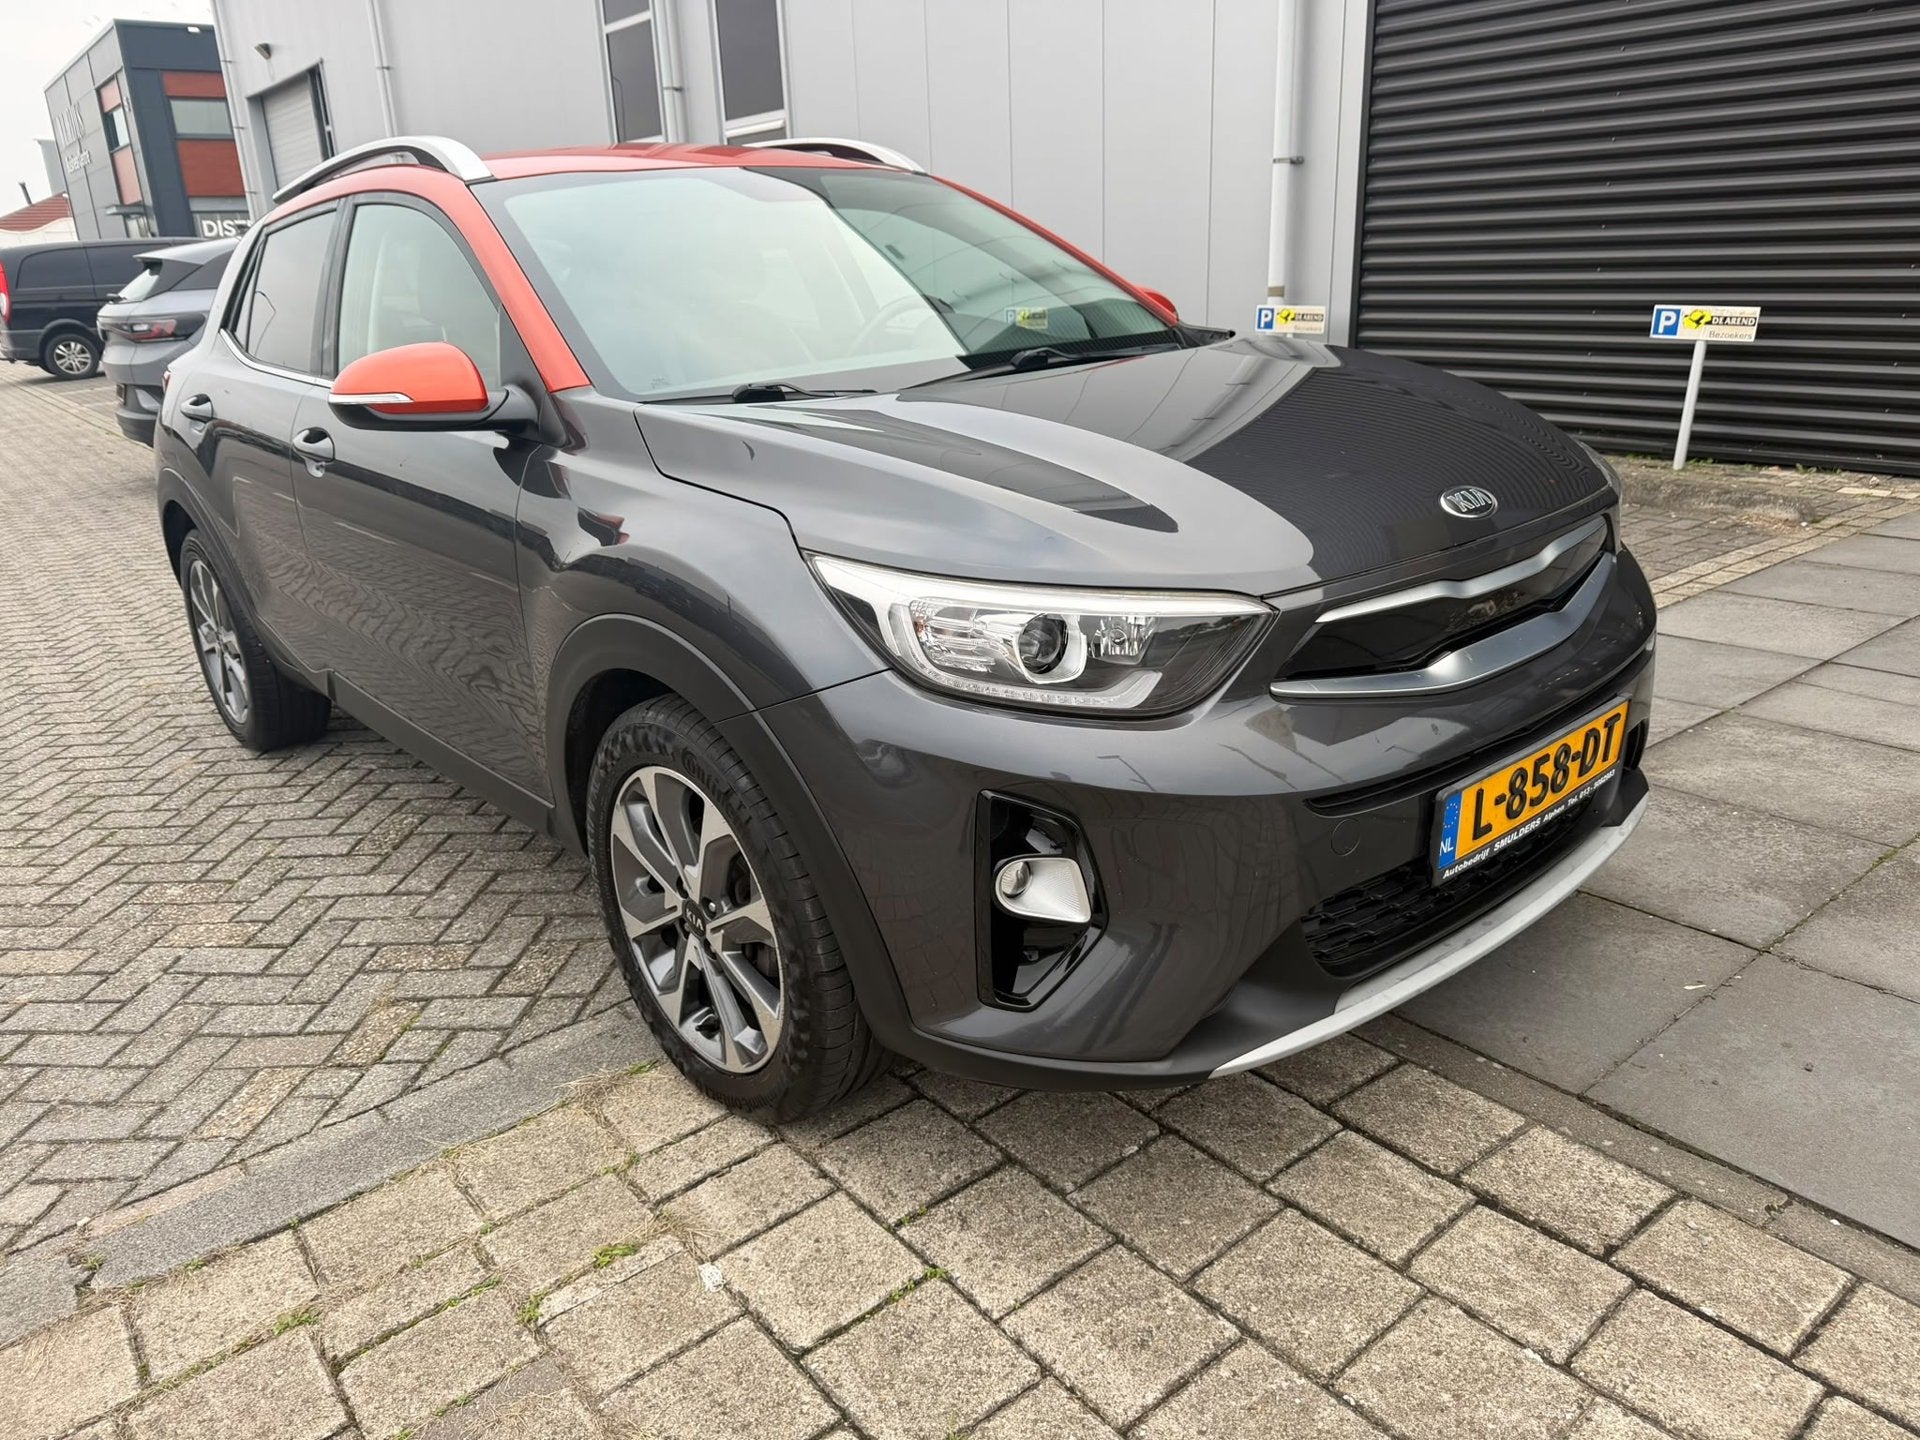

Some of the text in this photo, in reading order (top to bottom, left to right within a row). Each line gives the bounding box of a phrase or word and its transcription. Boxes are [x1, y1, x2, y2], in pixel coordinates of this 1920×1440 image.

[1260, 309, 1273, 328] P
[1658, 311, 1677, 334] P
[1725, 316, 1756, 326] AREND
[1708, 330, 1752, 340] Bezoekers
[1446, 488, 1492, 513] KIA
[1472, 712, 1622, 841] L-858-DT
[1439, 836, 1454, 857] NL
[1442, 847, 1491, 880] Autobedrijf
[1493, 817, 1542, 852] SMULDERS
[685, 907, 705, 932] KIA
